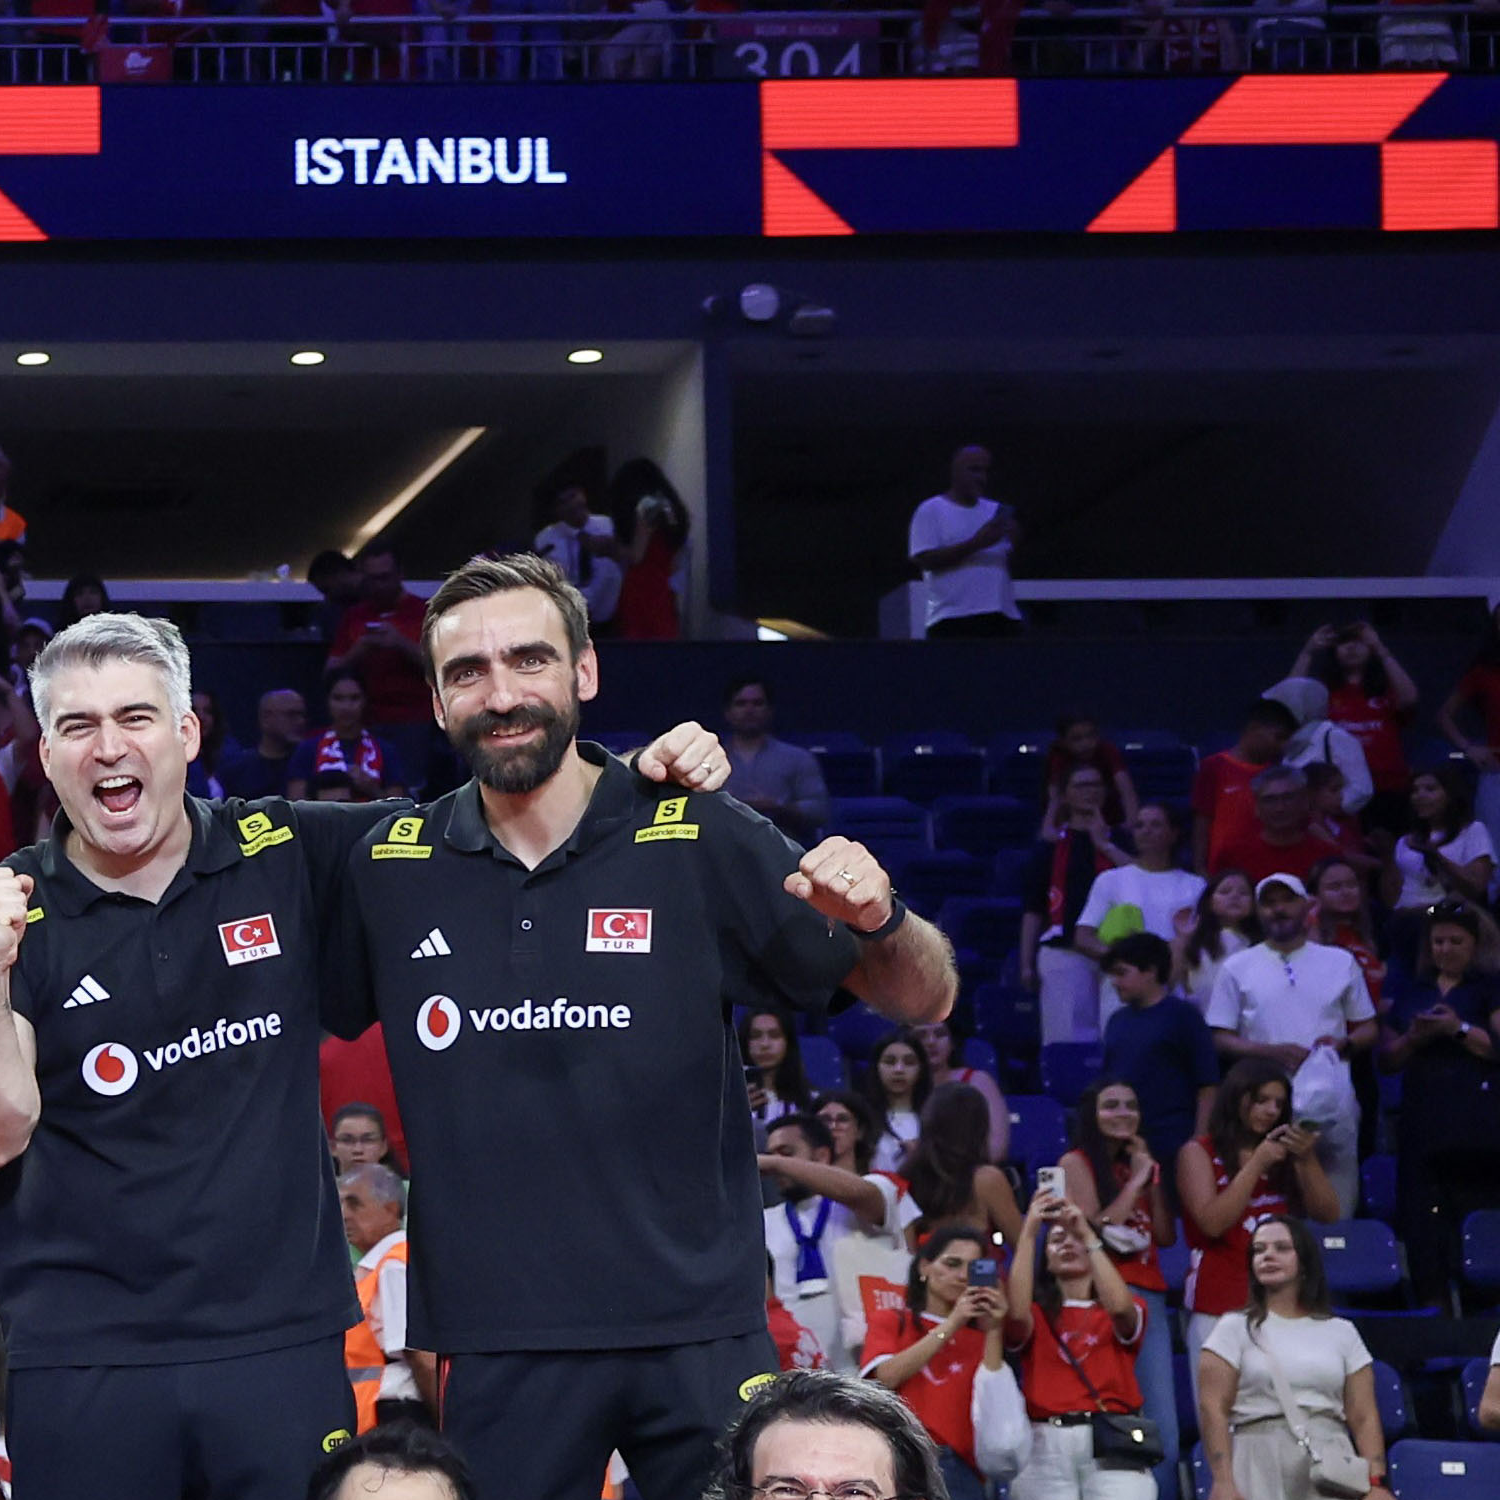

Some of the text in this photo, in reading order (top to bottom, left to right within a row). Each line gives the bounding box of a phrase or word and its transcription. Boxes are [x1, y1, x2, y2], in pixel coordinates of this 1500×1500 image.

[295, 138, 566, 185] ISTANBUL
[662, 801, 678, 820] S
[246, 819, 263, 834] S
[397, 822, 412, 841] S
[636, 826, 698, 843] sahibinden.com
[238, 946, 271, 960] TUR
[602, 940, 637, 952] TUR
[469, 1000, 632, 1034] vodafone
[143, 1011, 283, 1072] vodafone
